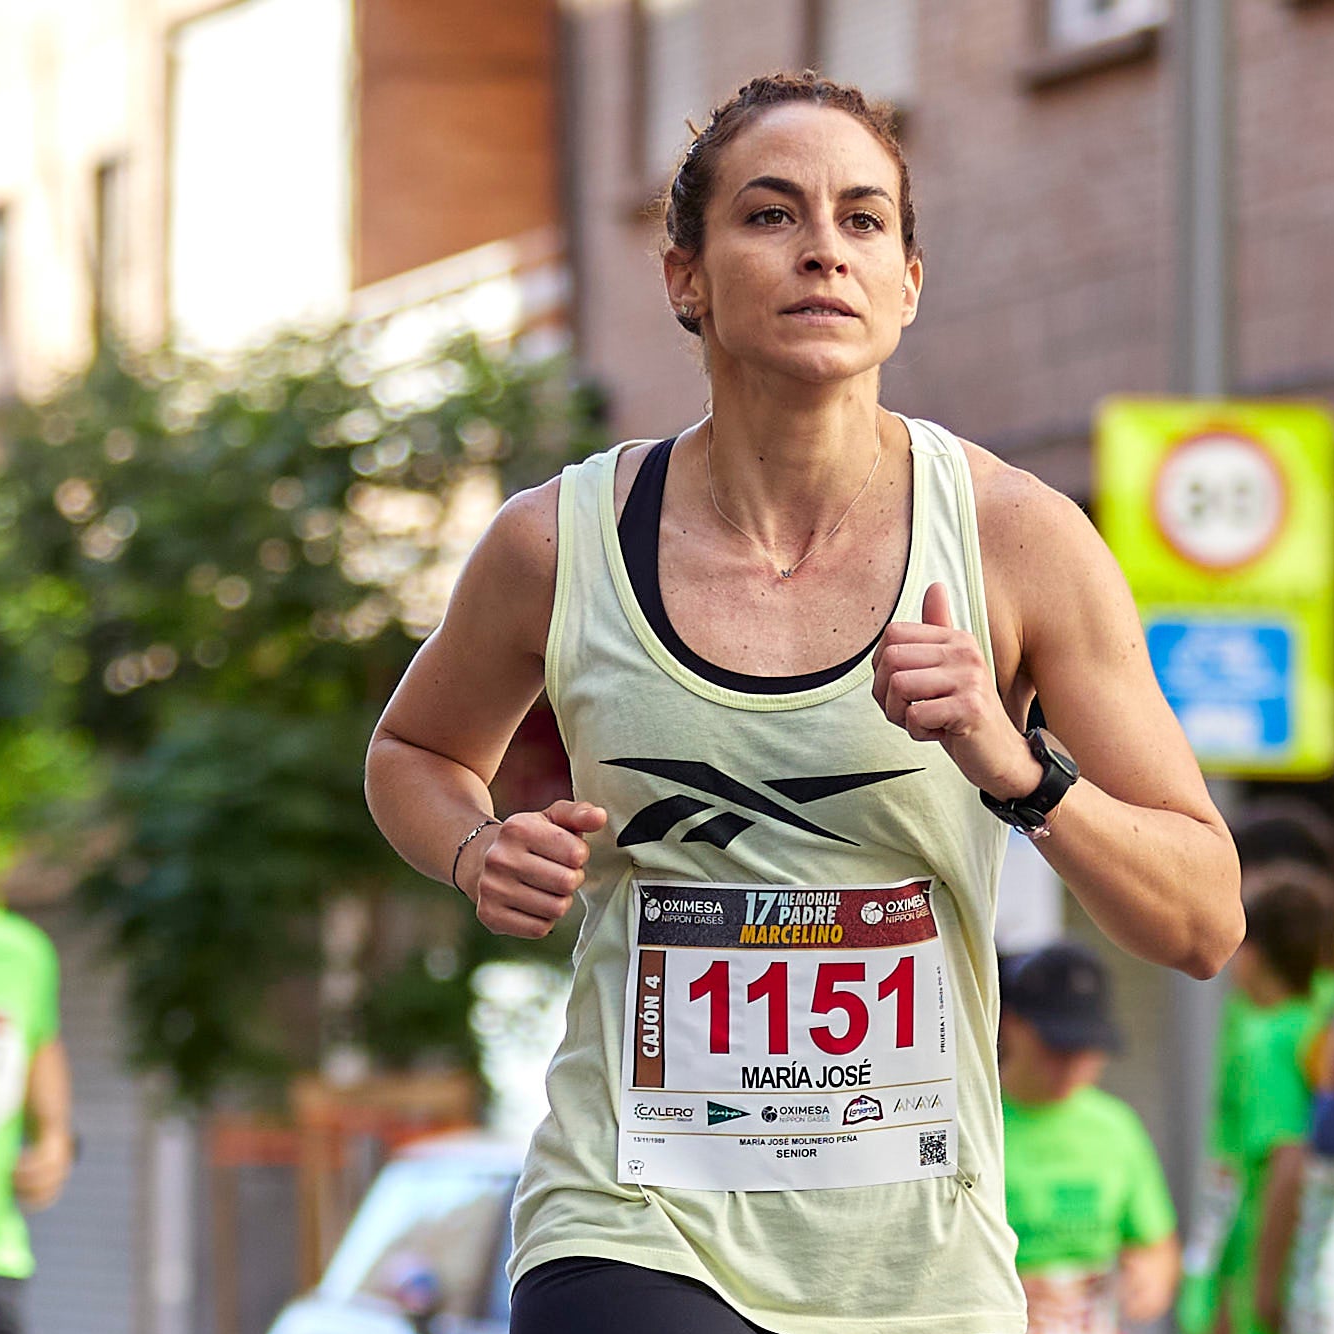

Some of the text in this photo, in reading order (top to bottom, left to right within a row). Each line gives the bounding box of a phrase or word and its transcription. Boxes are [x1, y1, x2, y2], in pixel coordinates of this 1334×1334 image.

[662, 899, 724, 914] OXIMESA
[745, 892, 841, 925] 17 MEMORIAL
[661, 914, 724, 925] NIPPON GASES
[779, 906, 837, 925] PADRE
[885, 912, 915, 924] NIPPON
[740, 924, 844, 944] MARCELINO
[688, 955, 915, 1056] 1151
[638, 975, 660, 1058] CAJÓN 4
[741, 1059, 872, 1088] MARÍA JOSÉ
[779, 1106, 830, 1115] OXIMESA
[893, 1094, 943, 1112] ANAYA
[638, 1106, 693, 1117] CALERO
[739, 1134, 858, 1146] MARÍA JOSÉ MOLINERO PEÑA
[776, 1149, 817, 1159] SENIOR
